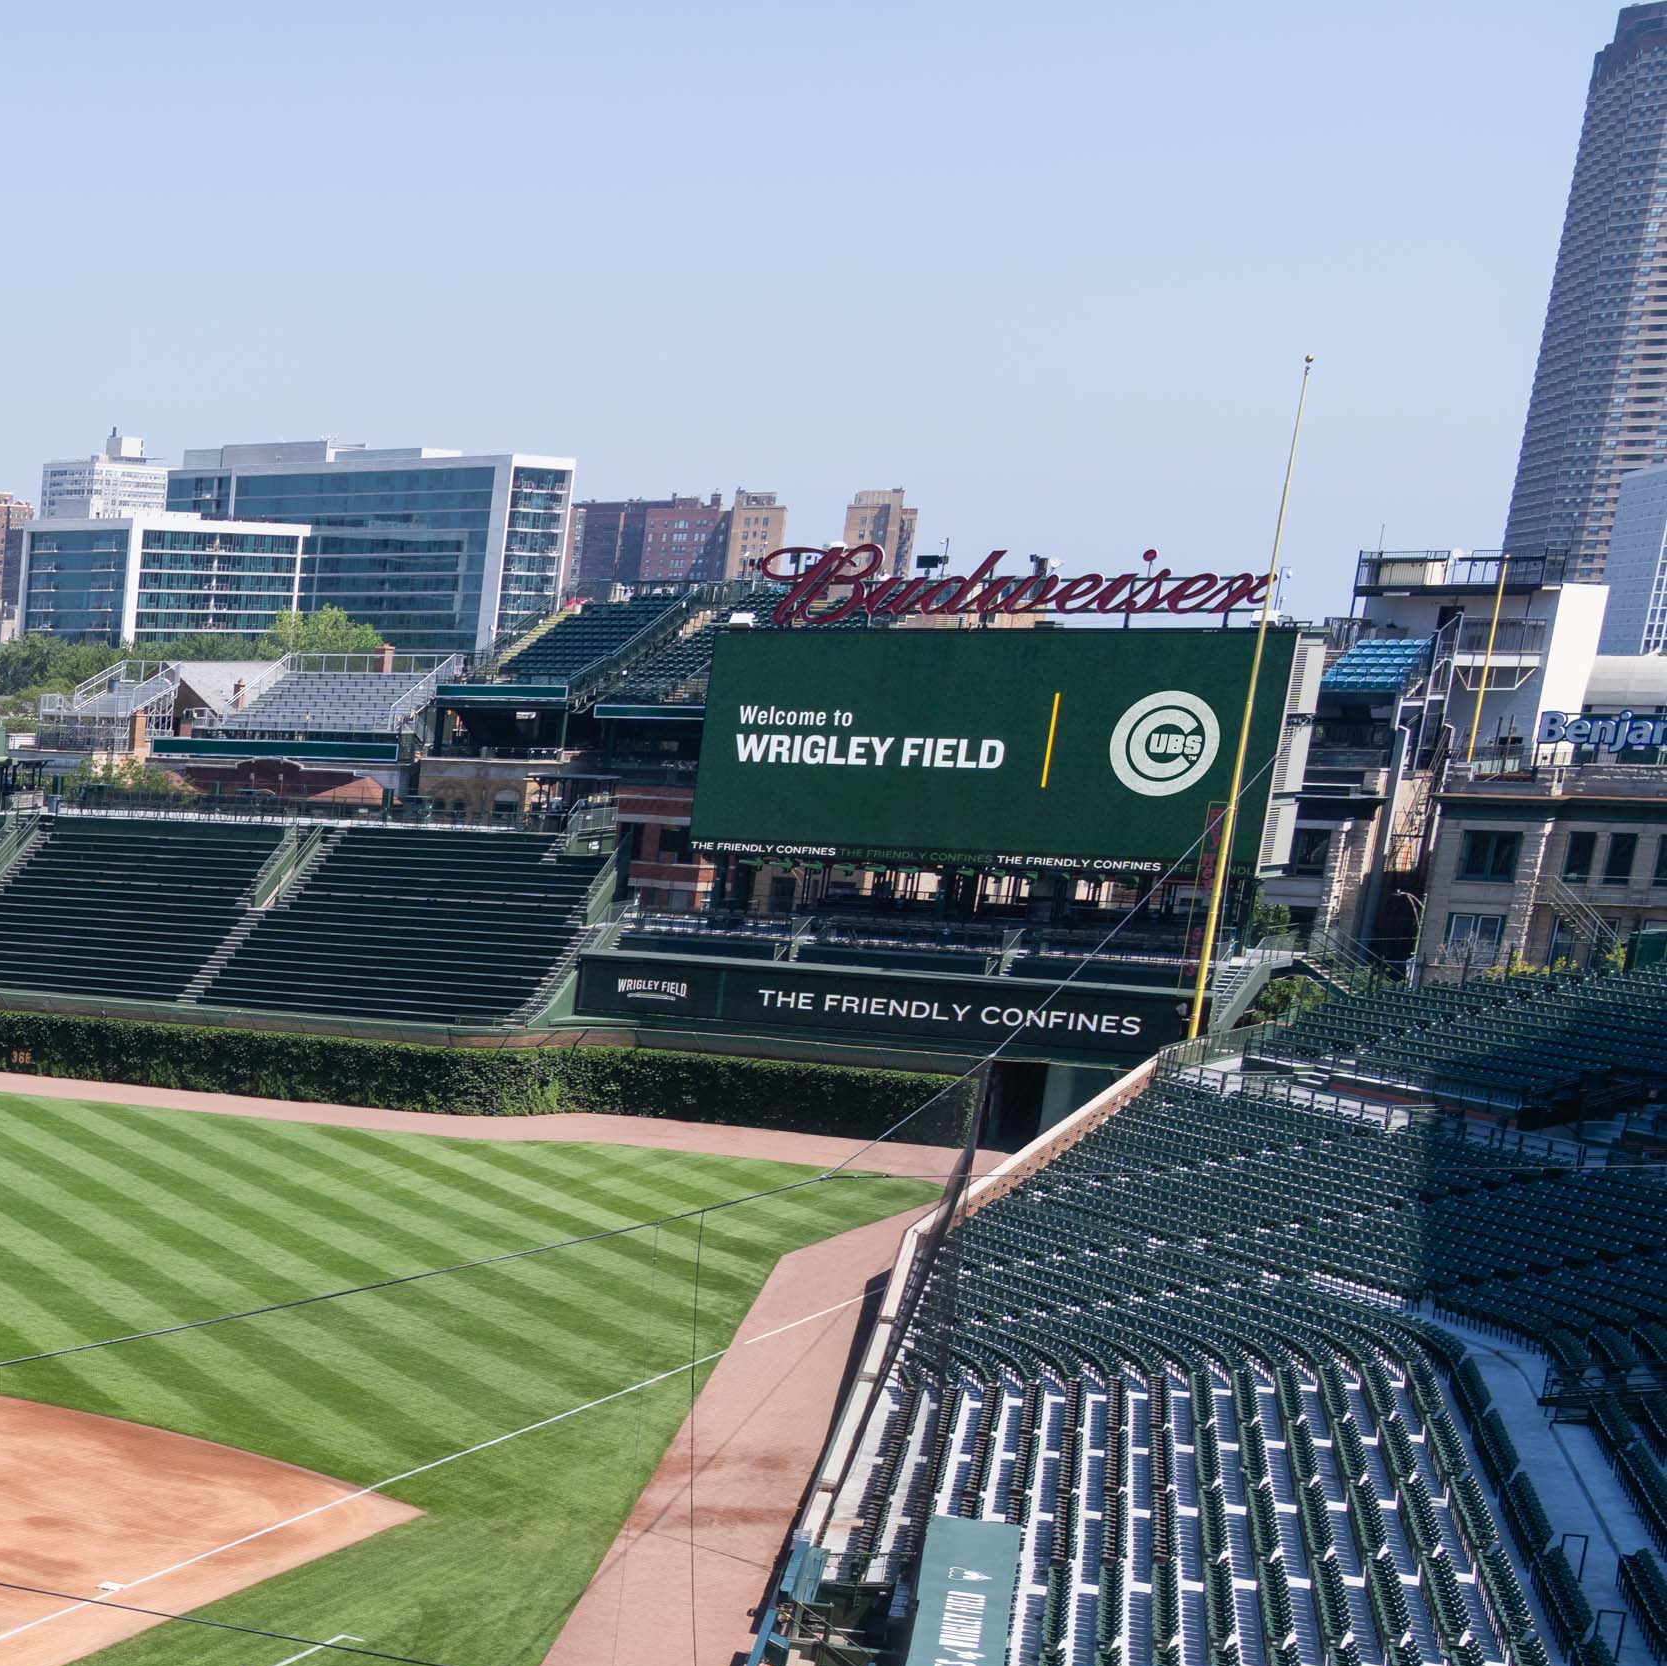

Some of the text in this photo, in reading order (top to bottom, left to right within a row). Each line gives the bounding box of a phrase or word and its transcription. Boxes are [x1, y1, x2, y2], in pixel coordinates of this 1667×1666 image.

[761, 544, 1278, 625] Budweiser
[740, 705, 853, 727] Welcome to
[736, 734, 1005, 769] WRIGLEY FIELD
[691, 841, 836, 856] THE FRIENDLY CONFINES
[867, 849, 927, 861] FRIENDLY
[930, 852, 993, 863] CONFINES
[996, 855, 1161, 871] THE FRIENDLY CONFINES
[618, 976, 687, 997] WRIGLEY FIELD
[759, 989, 1142, 1036] THE FRIENDLY CONFINES
[944, 1590, 987, 1614] FIELD
[939, 1612, 983, 1649] WRIGLEY
[943, 1647, 986, 1660] of
